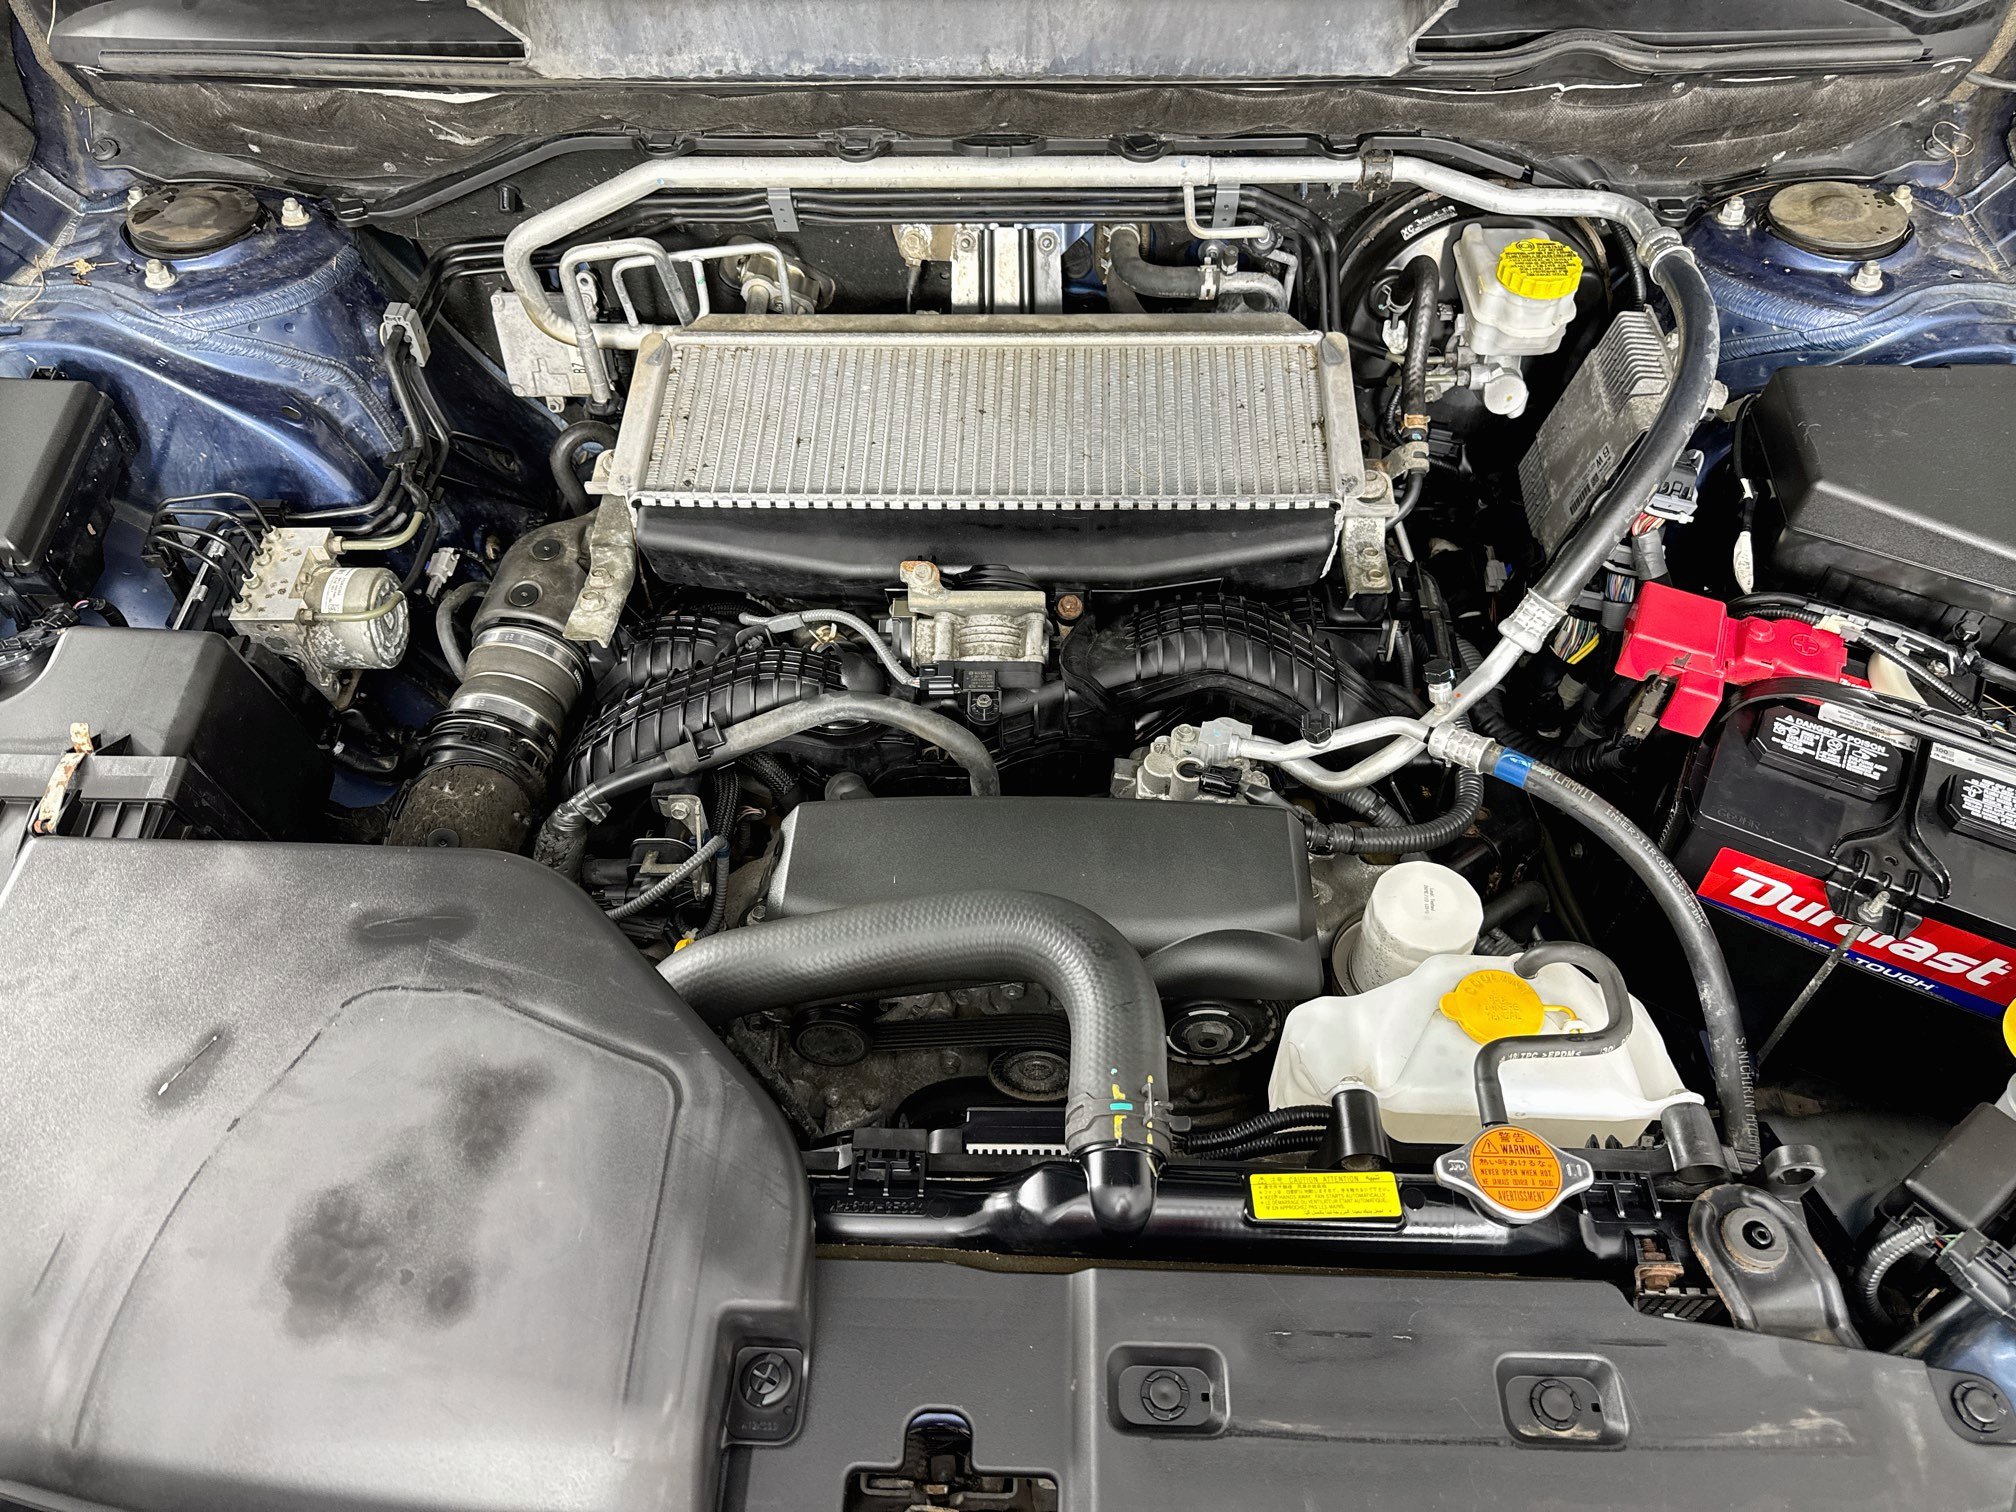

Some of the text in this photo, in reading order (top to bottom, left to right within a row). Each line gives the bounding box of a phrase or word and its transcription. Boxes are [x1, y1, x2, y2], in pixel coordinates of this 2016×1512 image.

[1795, 717, 1838, 737] DANGER
[1847, 735, 1886, 753] POISON
[1855, 957, 1934, 990] TOUGH
[1500, 1144, 1541, 1155] WARNING
[1480, 1168, 1500, 1176] NEVER
[1521, 1169, 1538, 1177] WHEN
[1322, 1175, 1359, 1183] ATTENTION
